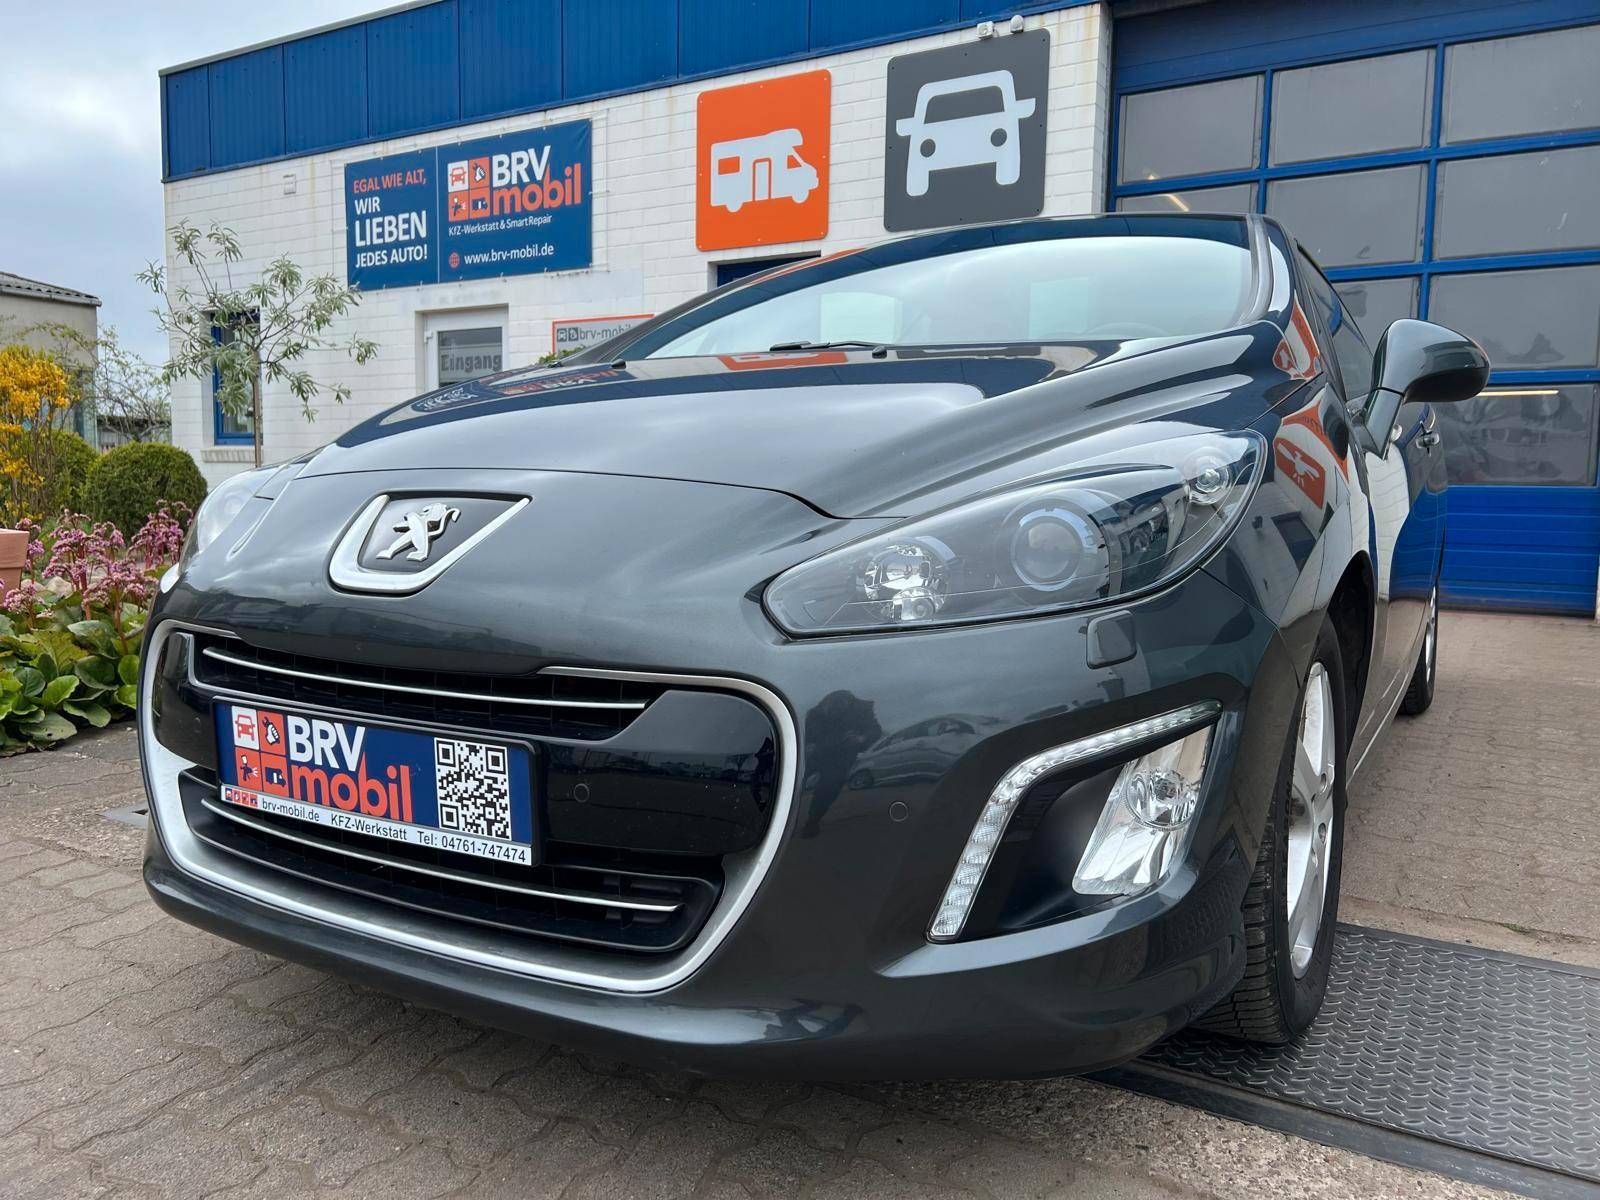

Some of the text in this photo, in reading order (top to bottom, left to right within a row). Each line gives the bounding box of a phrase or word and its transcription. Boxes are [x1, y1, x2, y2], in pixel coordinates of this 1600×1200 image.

[353, 168, 427, 194] EGAL WIE ALT,
[492, 145, 551, 188] BRV
[493, 163, 582, 216] mobil
[354, 196, 381, 215] WIR
[500, 219, 506, 229] &
[506, 216, 528, 229] Smart
[528, 213, 553, 226] Repair
[355, 210, 427, 247] LIEBEN
[355, 243, 428, 268] JEDES AUTO!
[464, 242, 554, 265] www.brv-mobil.de
[441, 353, 502, 373] Eingang
[287, 714, 366, 772] BRV
[291, 752, 413, 823] mobil
[262, 798, 526, 862] brv-mobil.de KFZ-Werkstatt Tel: 04761-747474
